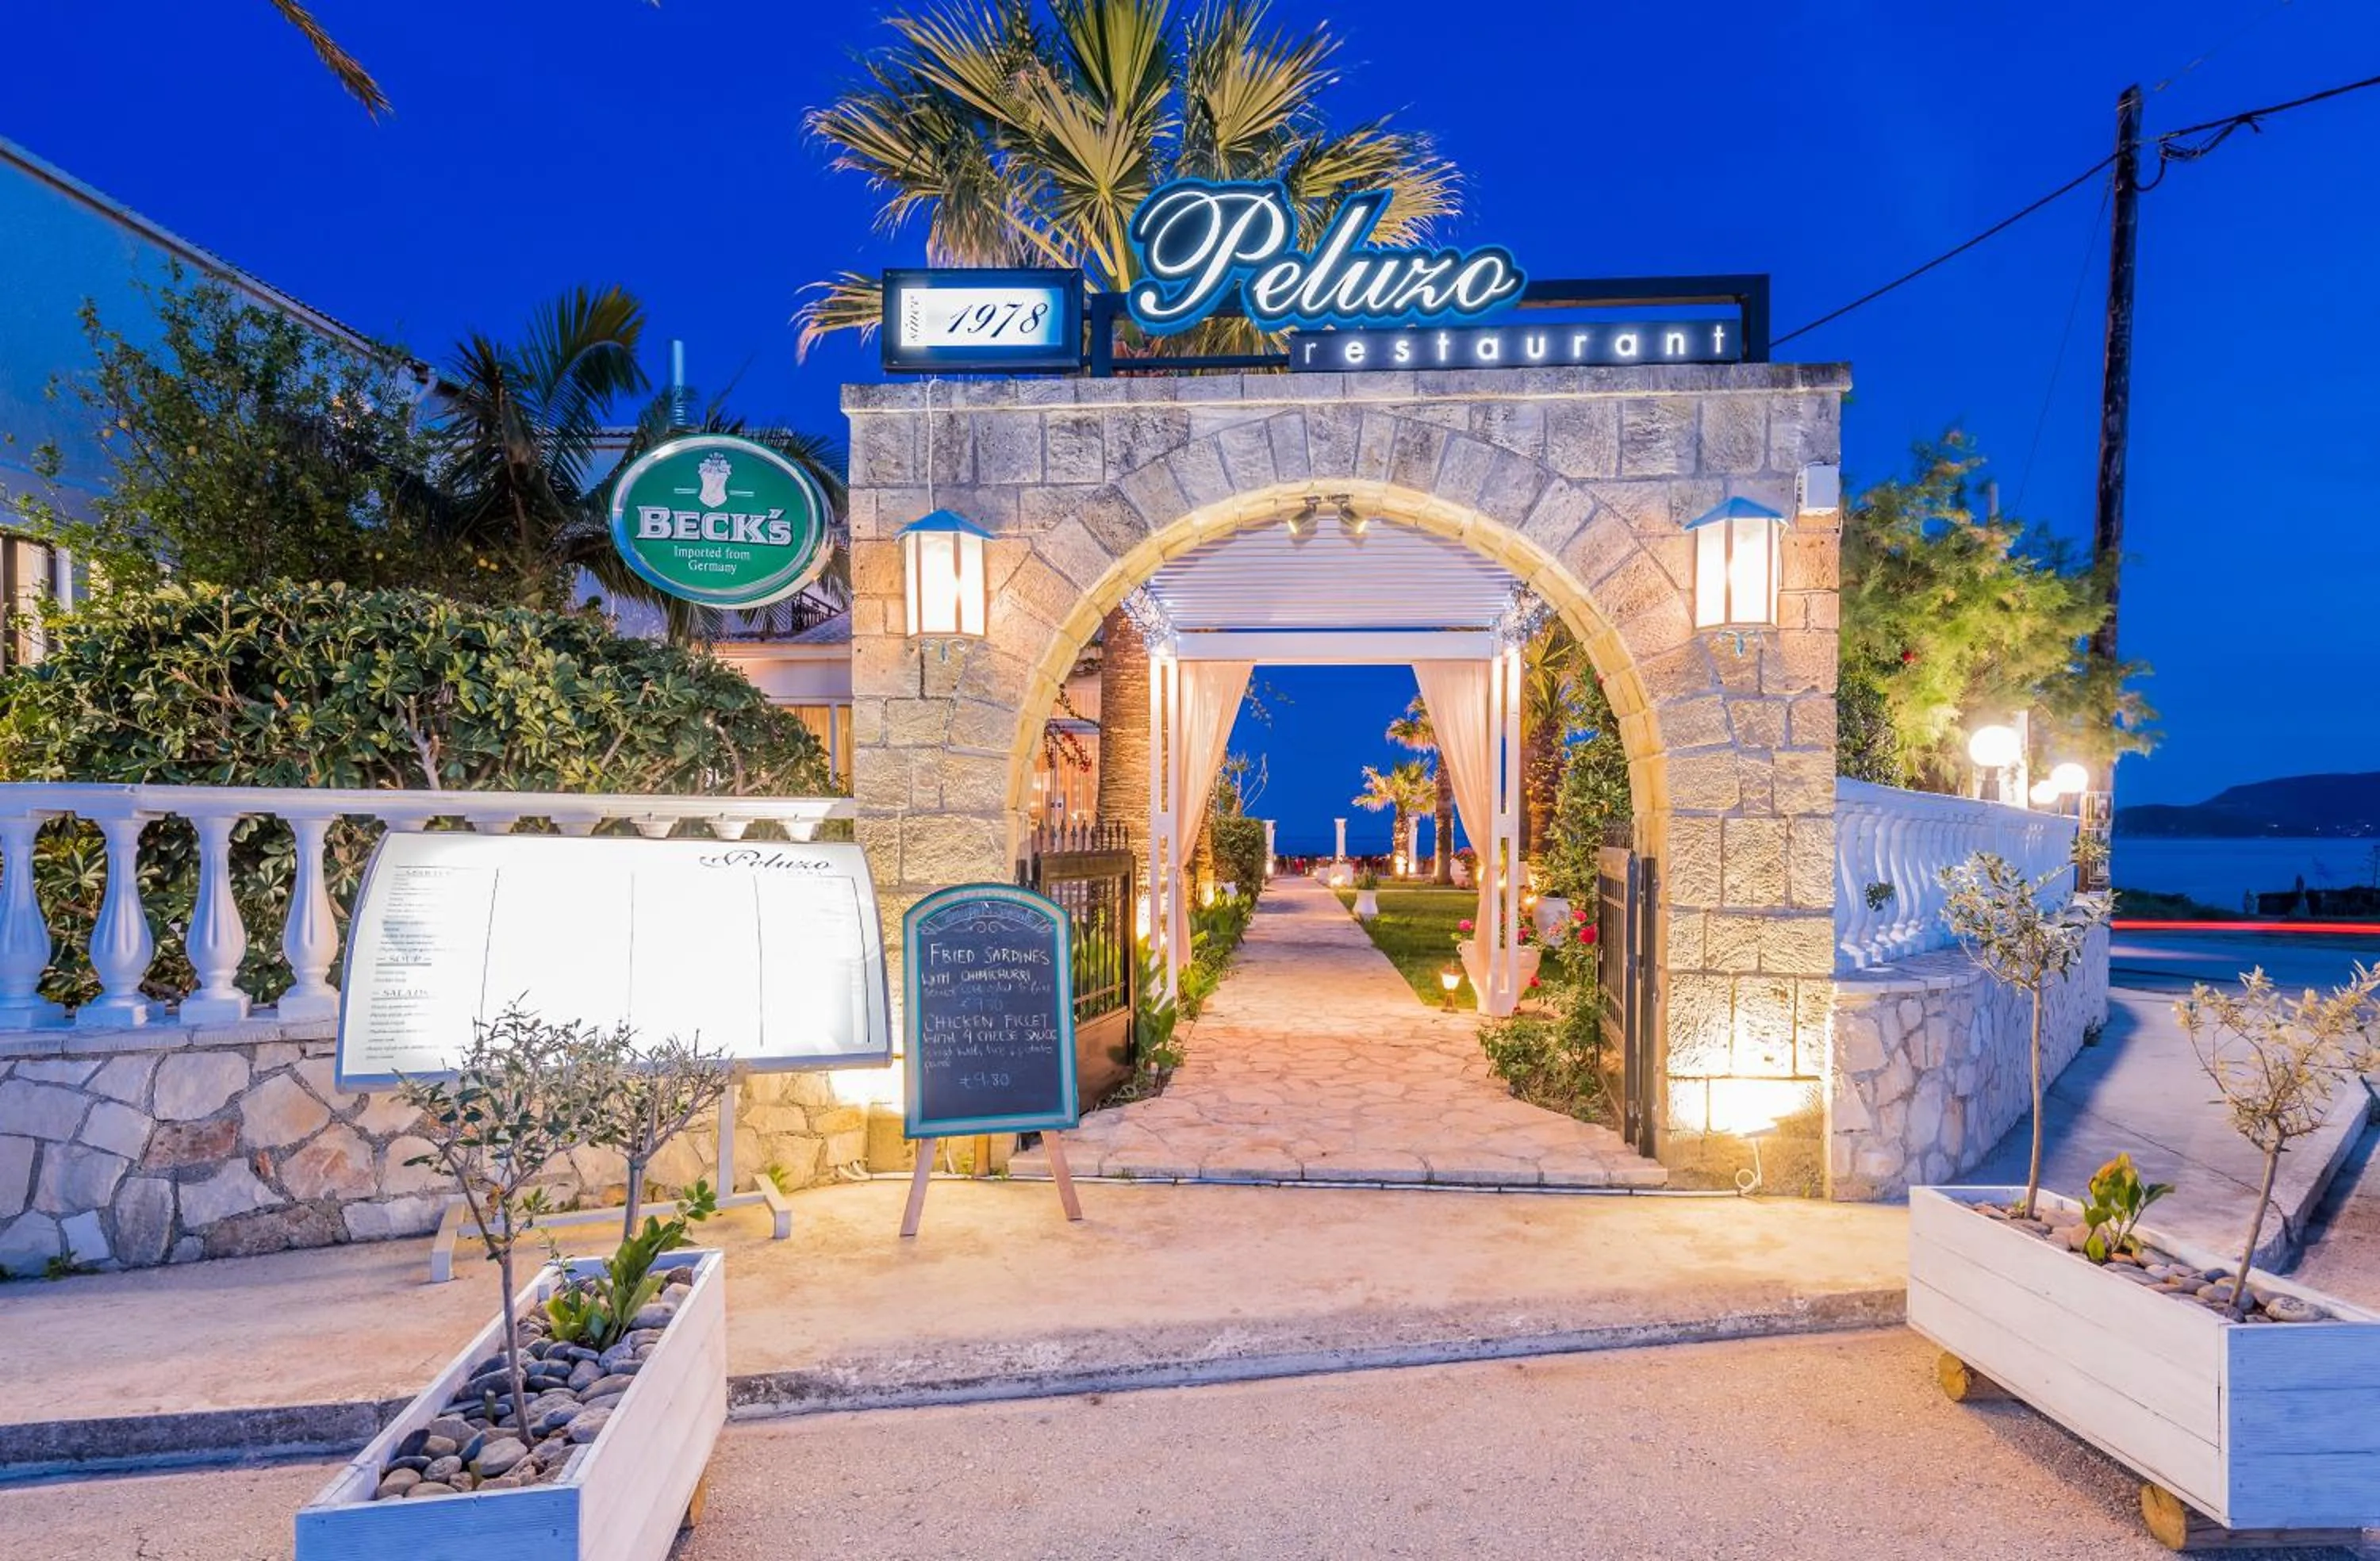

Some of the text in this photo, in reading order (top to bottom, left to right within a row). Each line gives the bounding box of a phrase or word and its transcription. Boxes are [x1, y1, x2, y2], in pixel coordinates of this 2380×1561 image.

[1139, 190, 1519, 316] Peluzo
[946, 301, 1050, 339] 1978
[1303, 324, 1726, 365] restaurant
[674, 545, 750, 560] Imported from
[688, 559, 737, 574] Germany
[930, 942, 1050, 965] FRIED SARDINES
[924, 1013, 993, 1031] CHICKEN
